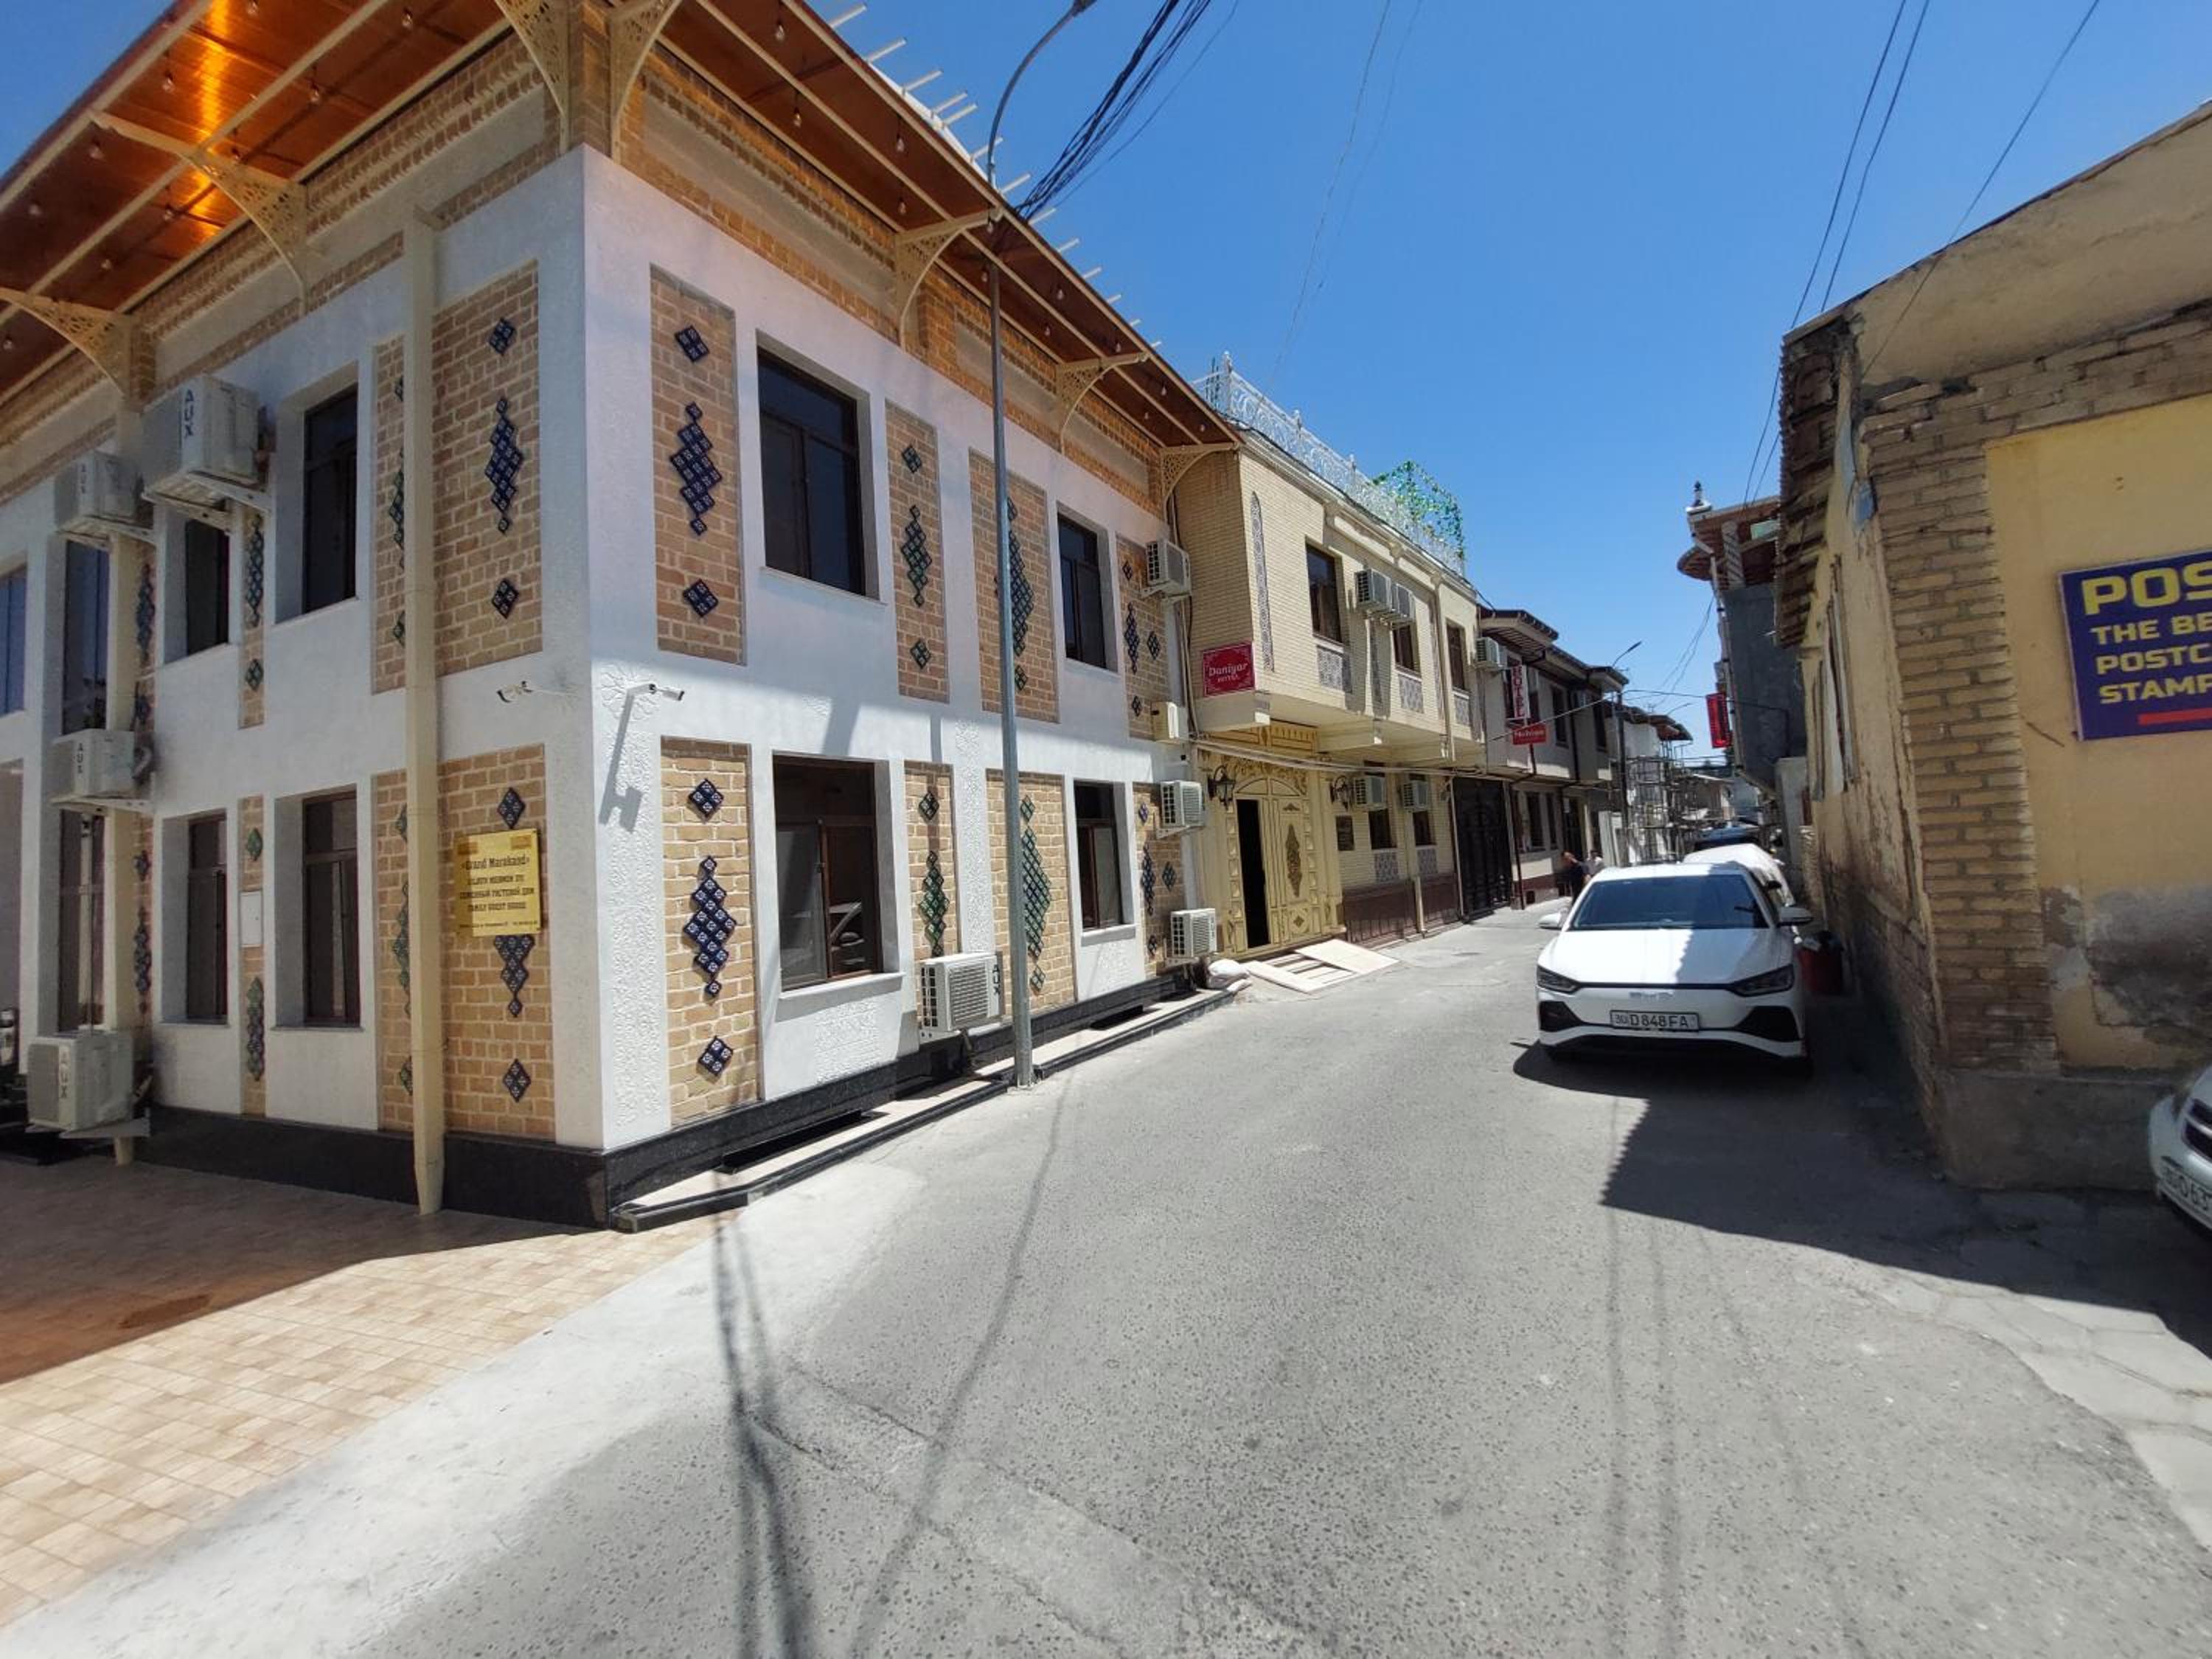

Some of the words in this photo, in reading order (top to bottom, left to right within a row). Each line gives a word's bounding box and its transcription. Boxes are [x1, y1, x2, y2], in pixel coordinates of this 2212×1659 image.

[2081, 560, 2212, 616] POS
[2090, 619, 2160, 645] THE
[2171, 612, 2212, 635] BE
[1209, 663, 1248, 676] Daniyar
[2096, 643, 2212, 675] POSTC
[1630, 1013, 1689, 1029] D848FA
